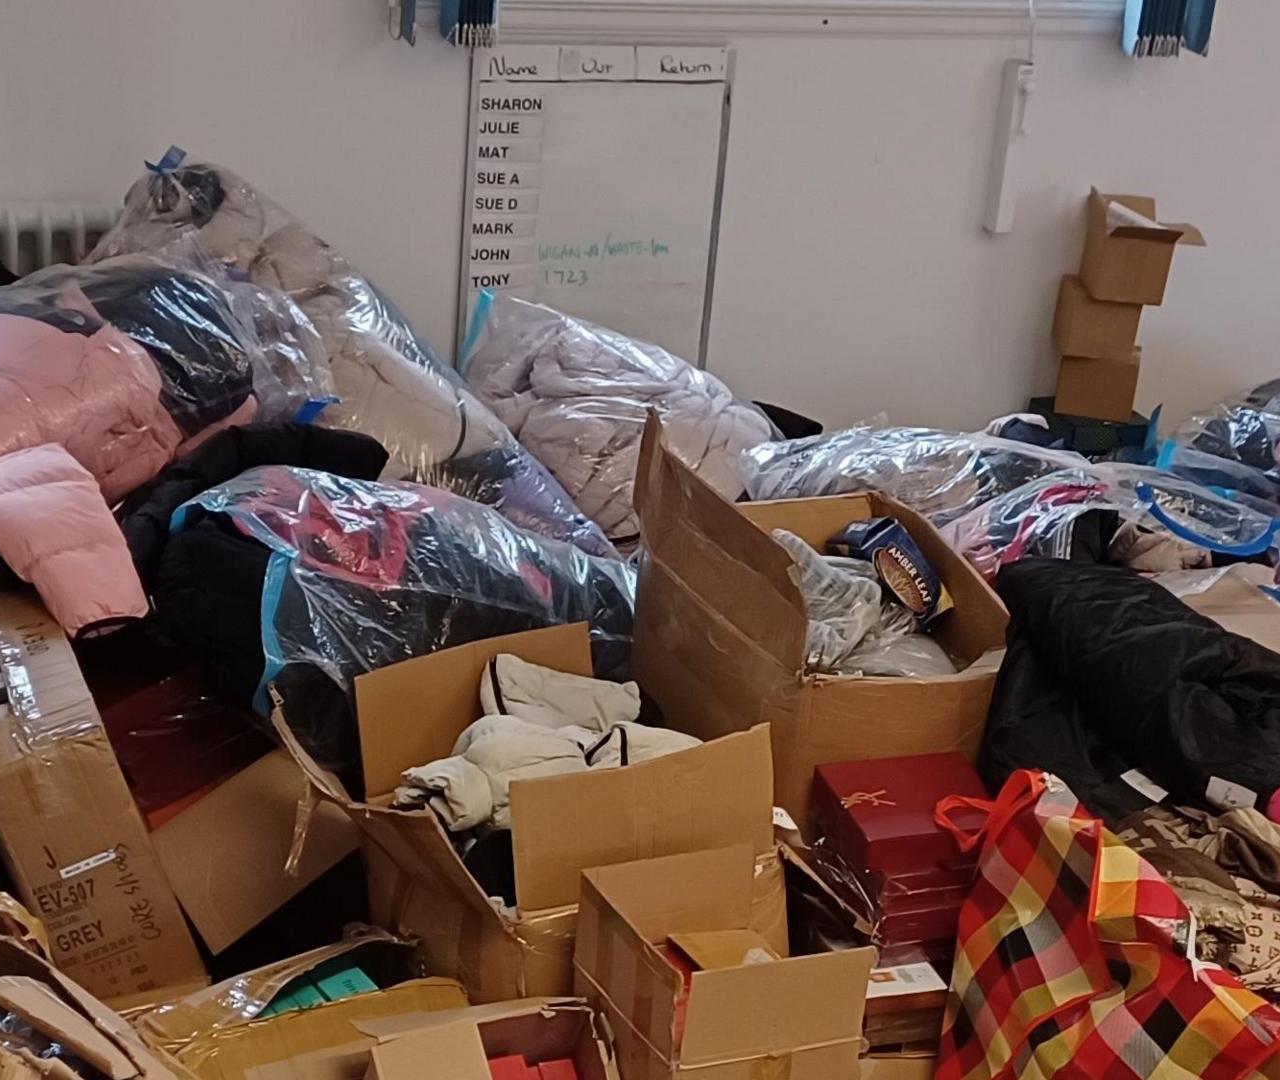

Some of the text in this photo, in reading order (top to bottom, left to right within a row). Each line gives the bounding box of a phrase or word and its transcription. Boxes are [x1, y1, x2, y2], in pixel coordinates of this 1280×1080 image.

[489, 56, 538, 77] Name
[660, 54, 711, 74] Return
[481, 98, 542, 111] SHARON
[479, 122, 520, 134] JULIE
[478, 147, 509, 159] MAT
[477, 173, 520, 185] SUE A
[475, 198, 518, 210] SUE D
[472, 223, 514, 235] MARK
[471, 249, 510, 261] JOHN
[472, 274, 510, 288] TONY
[544, 269, 589, 286] 1723
[888, 547, 931, 602] AMBER LEAF
[36, 878, 96, 914] EV-507
[55, 919, 106, 952] GREY
